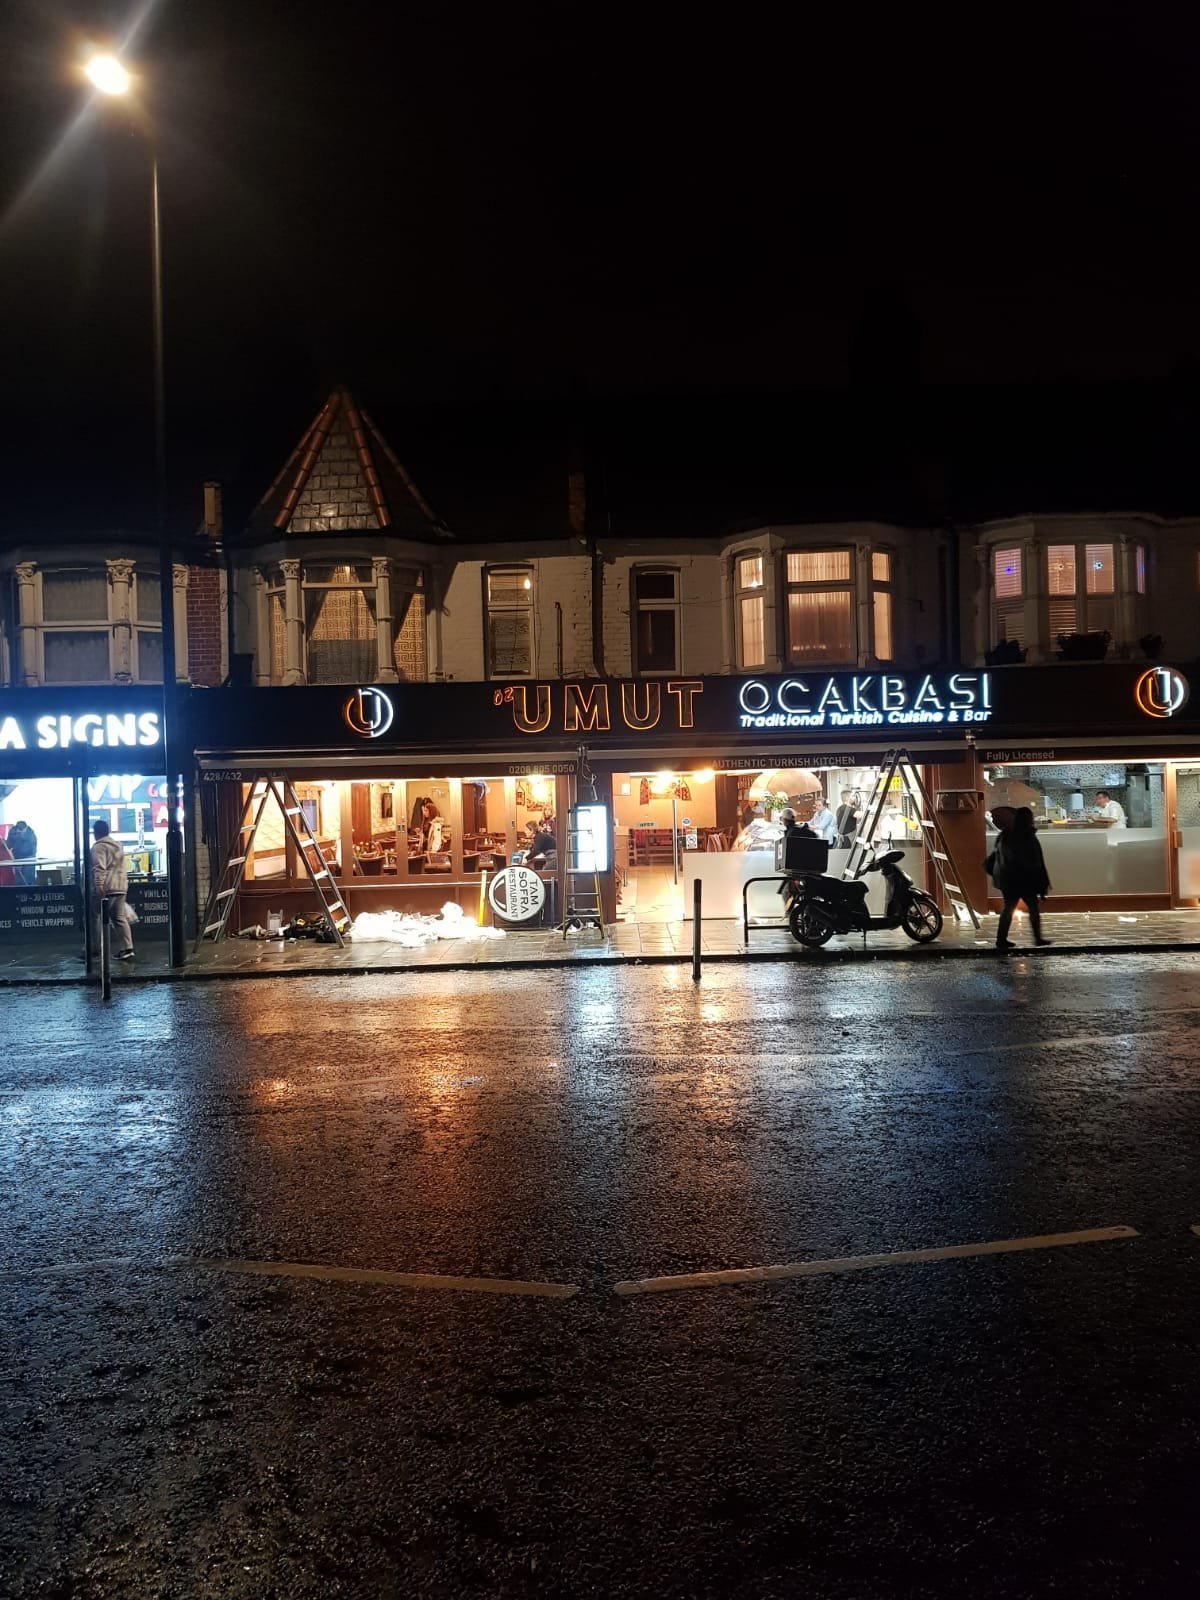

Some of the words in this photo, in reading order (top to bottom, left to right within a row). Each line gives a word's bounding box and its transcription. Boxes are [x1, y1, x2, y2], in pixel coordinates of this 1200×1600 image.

[512, 681, 704, 733] UMUT
[739, 712, 824, 728] Traditional
[830, 711, 883, 726] Turkish
[888, 710, 943, 724] Cuisine
[947, 710, 959, 722] &
[964, 709, 992, 722] Bar
[0, 717, 26, 749] A
[36, 712, 161, 749] SIGNS
[711, 758, 766, 769] AUTHENTIC
[768, 757, 810, 768] TURKISH
[813, 755, 856, 766] KITCHEN
[986, 751, 1010, 762] Fully
[1012, 750, 1055, 760] Licensed
[203, 771, 242, 782] 428/432
[552, 763, 575, 774] 0050
[508, 868, 519, 918] RESTAURANT
[518, 871, 529, 914] SOFRA
[529, 878, 539, 906] TAM
